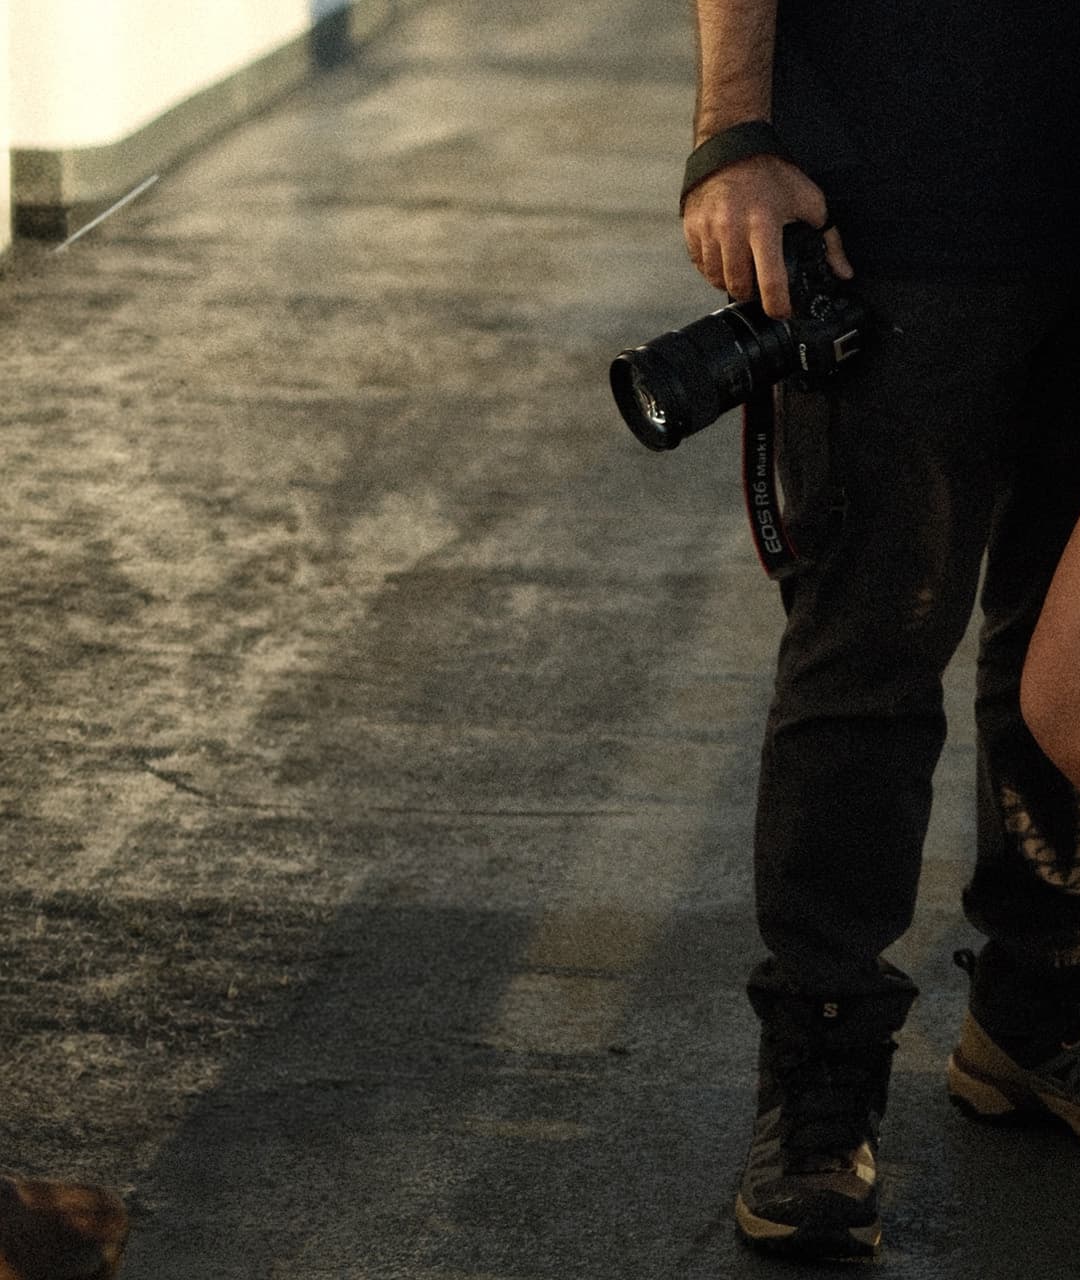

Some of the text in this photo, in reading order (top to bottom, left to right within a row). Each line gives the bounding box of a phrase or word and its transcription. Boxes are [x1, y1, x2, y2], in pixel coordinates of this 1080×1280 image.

[757, 443, 768, 477] Mark
[752, 479, 771, 507] R6
[757, 508, 783, 554] EOS
